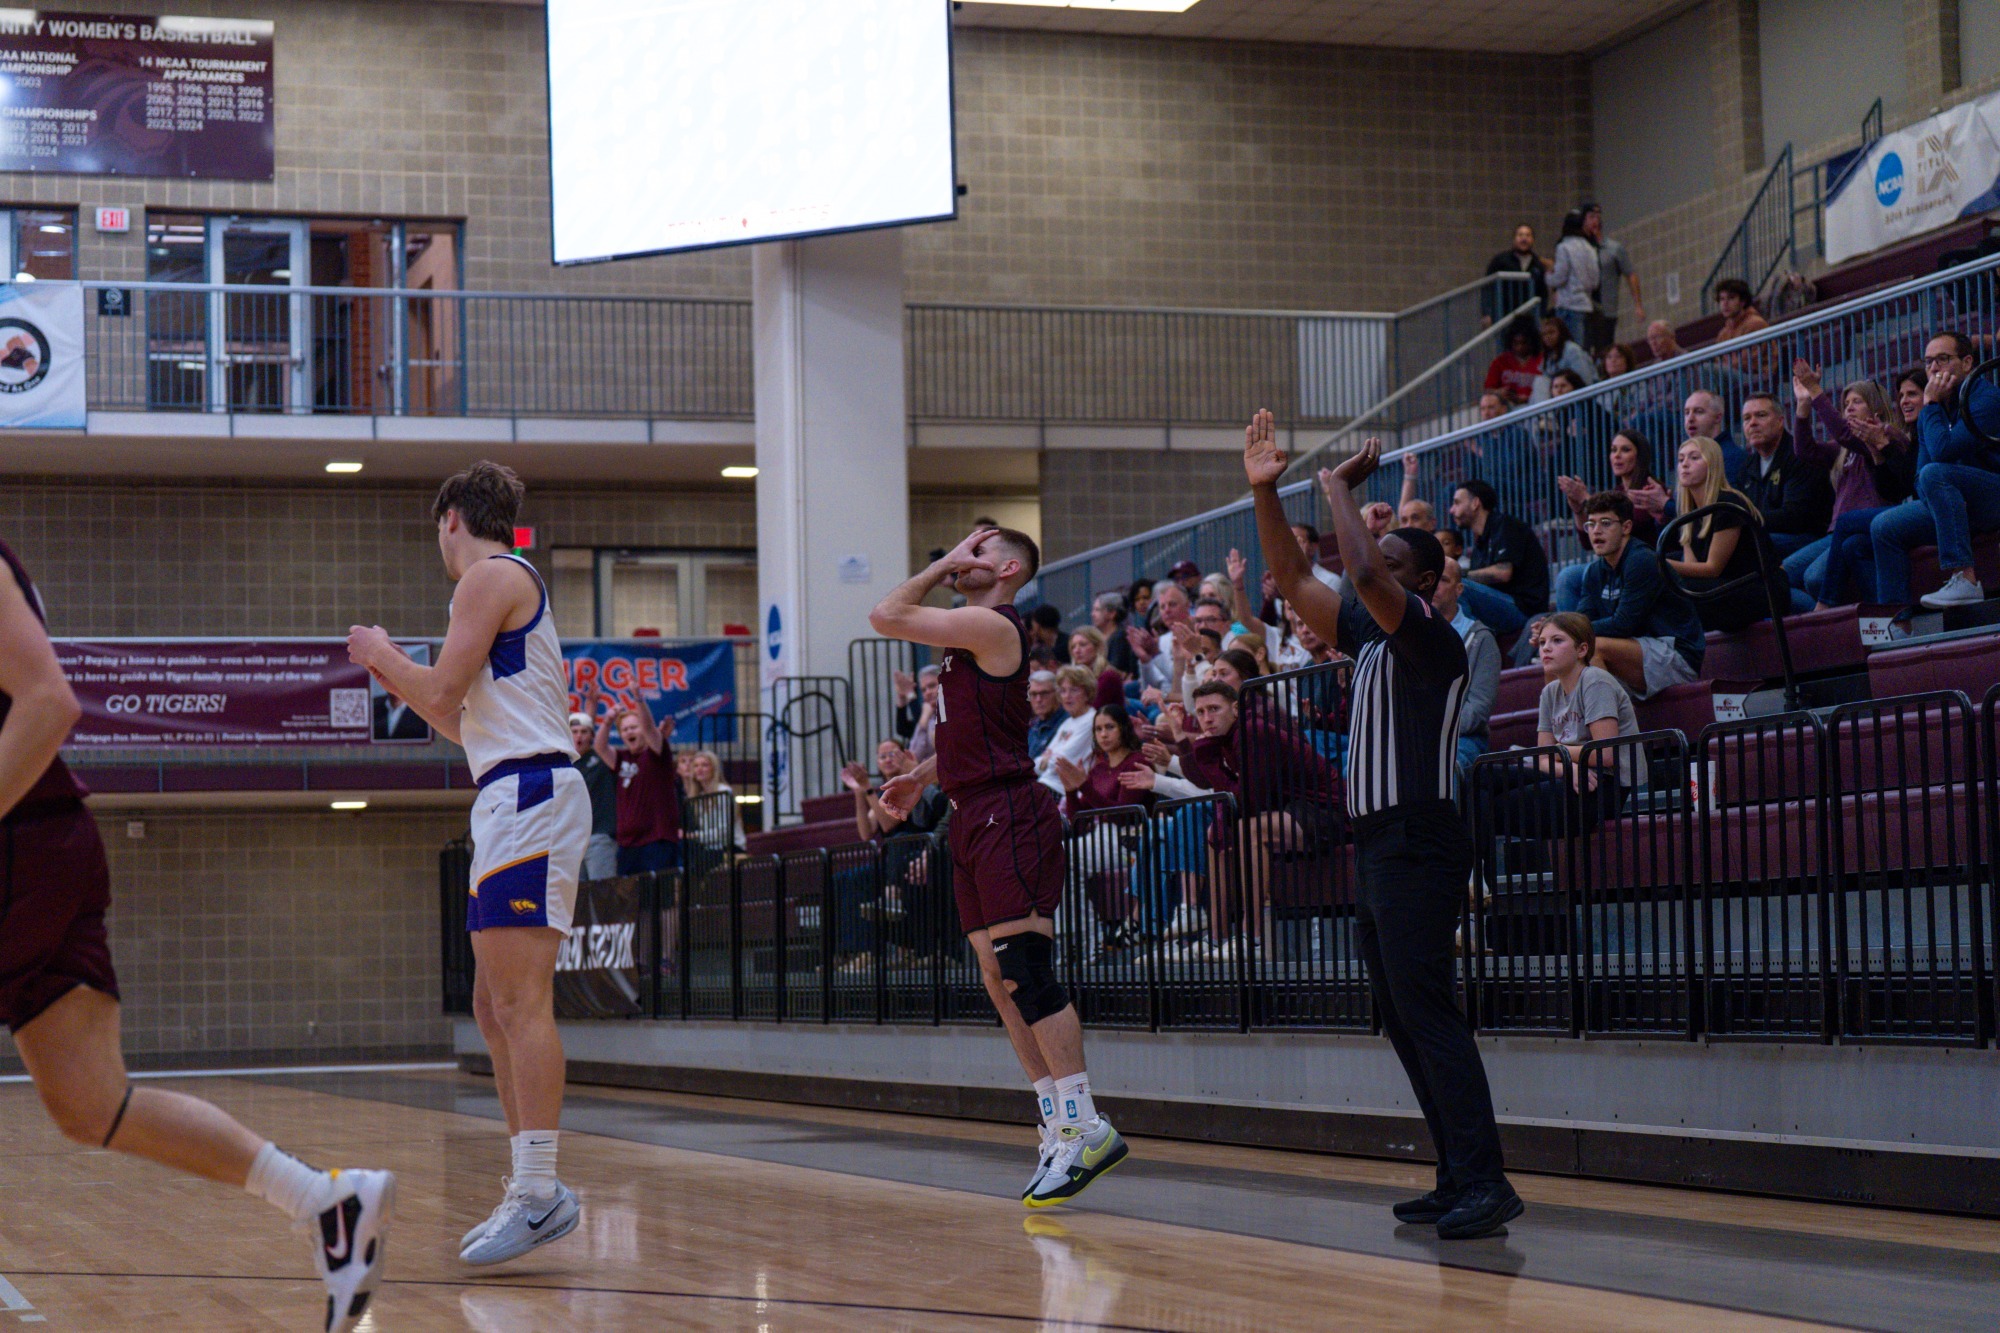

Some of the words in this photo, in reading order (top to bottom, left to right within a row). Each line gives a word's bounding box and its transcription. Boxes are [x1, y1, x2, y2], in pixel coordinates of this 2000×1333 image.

[49, 21, 137, 40] WOMEN'S
[140, 24, 257, 46] BASKETBALL
[21, 50, 79, 64] NATIONAL
[140, 57, 152, 67] 14
[156, 57, 188, 69] NCAA
[190, 58, 267, 73] TOURNAMENT
[163, 69, 245, 83] APPEARANCES
[2, 107, 98, 121] CHAMPIONSHIPS
[146, 106, 175, 119] 2017,
[102, 210, 125, 229] EXIT
[106, 694, 142, 714] GO
[145, 694, 227, 714] TIGERS!
